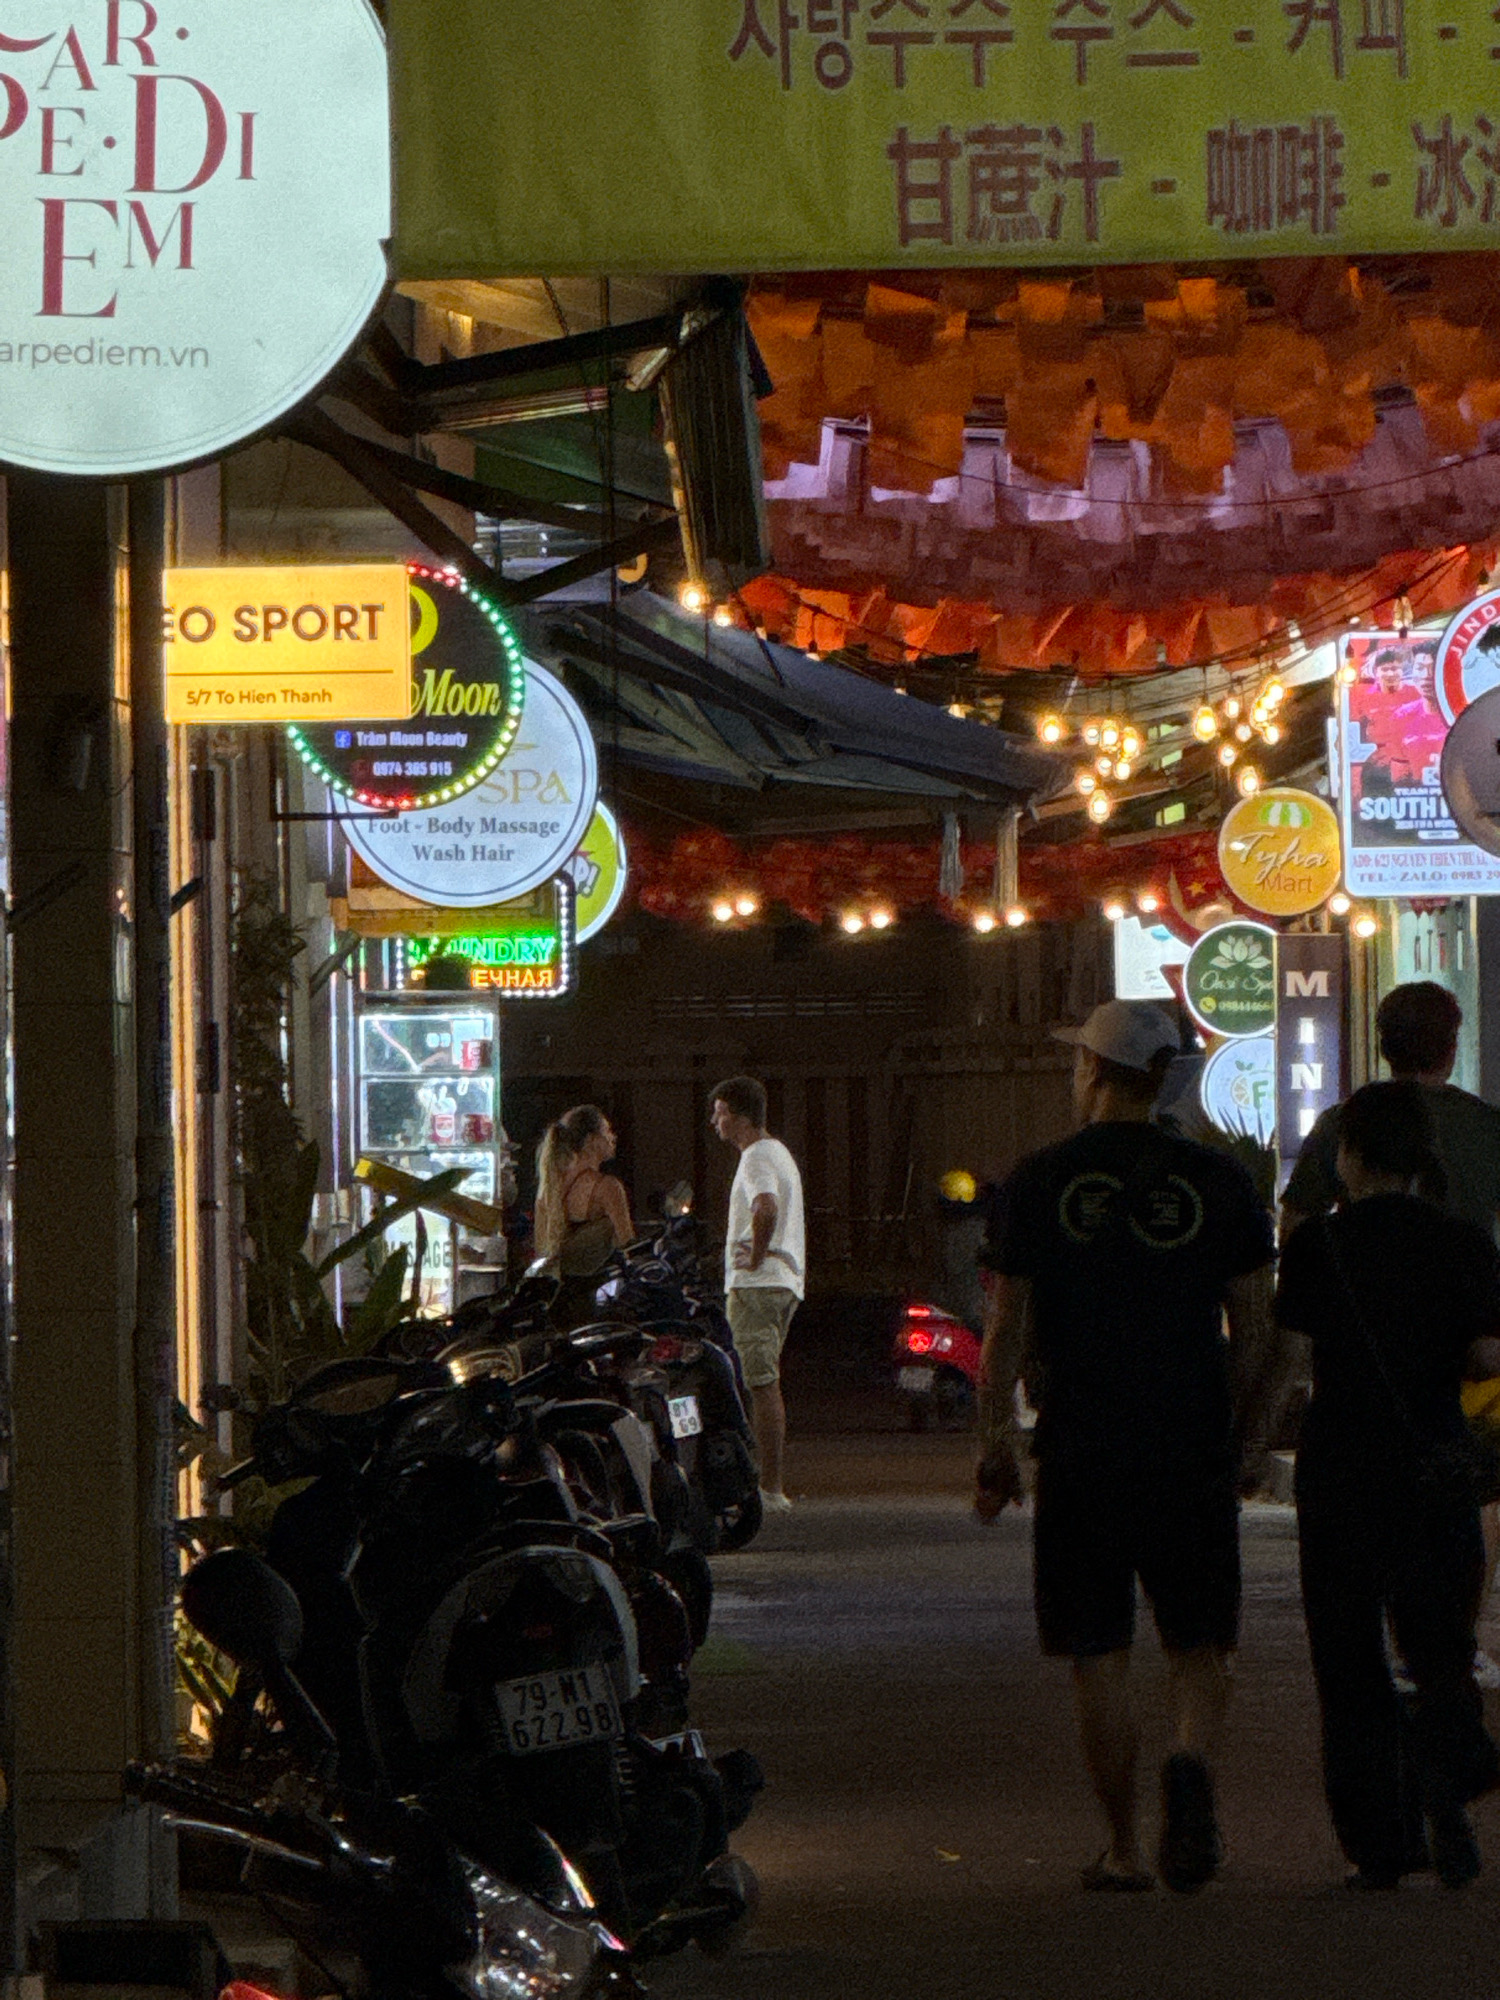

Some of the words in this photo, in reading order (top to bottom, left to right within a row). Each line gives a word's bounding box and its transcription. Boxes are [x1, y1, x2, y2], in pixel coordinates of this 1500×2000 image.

[887, 121, 1122, 247] 甘蔗汁
[1206, 115, 1347, 234] 咖啡
[233, 603, 384, 643] SPORT
[187, 690, 213, 705] 5/7
[216, 689, 235, 705] To
[239, 689, 277, 705] Hien
[281, 688, 332, 704] Thanh
[1360, 797, 1437, 820] SOUTH
[427, 816, 476, 838] Body
[480, 816, 560, 837] Massage
[413, 844, 466, 862] Wash
[472, 844, 515, 862] Hair
[1262, 874, 1312, 893] Mart
